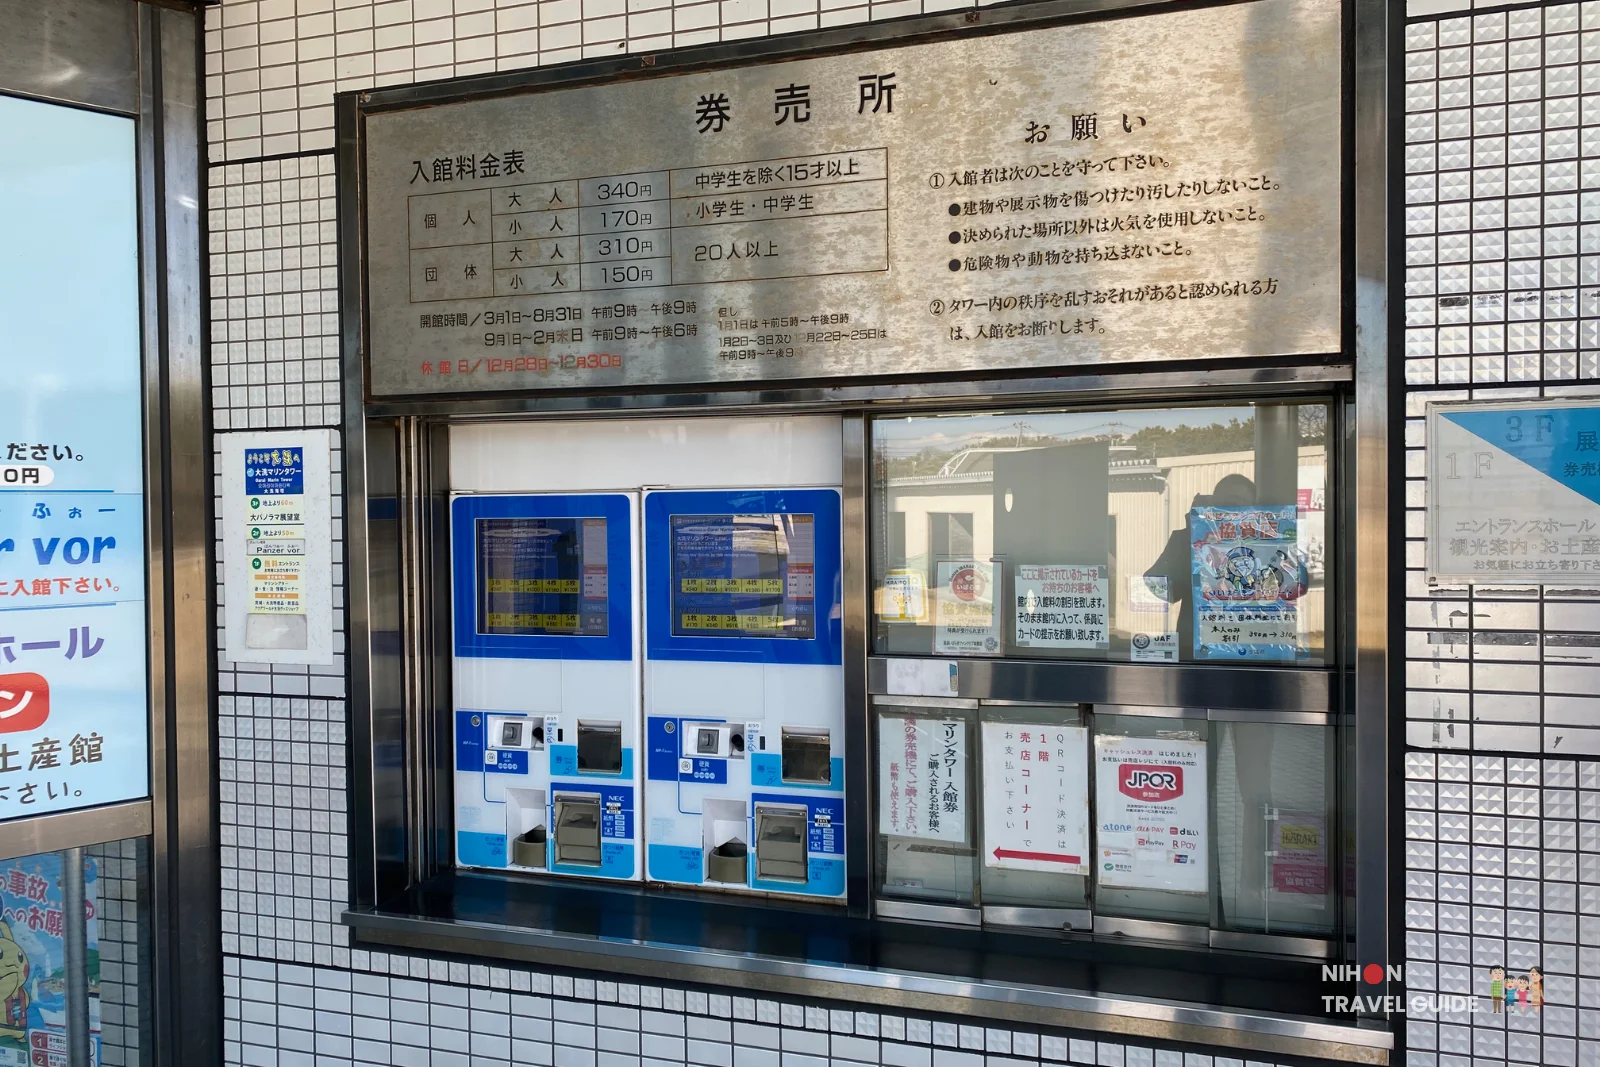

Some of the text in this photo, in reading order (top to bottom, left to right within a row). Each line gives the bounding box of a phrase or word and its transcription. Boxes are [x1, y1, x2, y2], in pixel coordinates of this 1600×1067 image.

[695, 72, 897, 133] 券売所
[1025, 112, 1147, 144] お願い
[409, 149, 525, 184] 入館料金表
[508, 158, 860, 208] 大人 340円 中学生を除く15才以上
[424, 209, 476, 229] 個人
[509, 193, 814, 235] 小人 170円 小学生・中学生
[509, 237, 779, 262] 大人 310円 20人以上
[963, 241, 1193, 272] 危険物や動物を持ち込まないこと。
[425, 263, 478, 282] 団体
[510, 265, 653, 290] 小人 150円
[718, 306, 738, 318] 但し
[0, 442, 84, 461] ださい。
[1563, 461, 1600, 478] 券売
[1219, 521, 1280, 539] 協賛店
[1455, 518, 1597, 535] エントランスホール
[32, 536, 116, 565] vor
[1041, 582, 1100, 594] お持ちのお客様へ
[1154, 634, 1171, 642] JAF
[1211, 625, 1241, 633] 本人のみ
[942, 722, 959, 813] マリンタワー 入館券
[1004, 731, 1015, 829] お支払い下さい
[890, 762, 899, 832] 紙幣も使えます。
[928, 752, 940, 833] ご購入されるお客様へ
[1020, 731, 1032, 847] 売店コーナーで
[815, 807, 834, 815] NEC
[1103, 823, 1132, 831] atone
[1180, 840, 1197, 850] Pay
